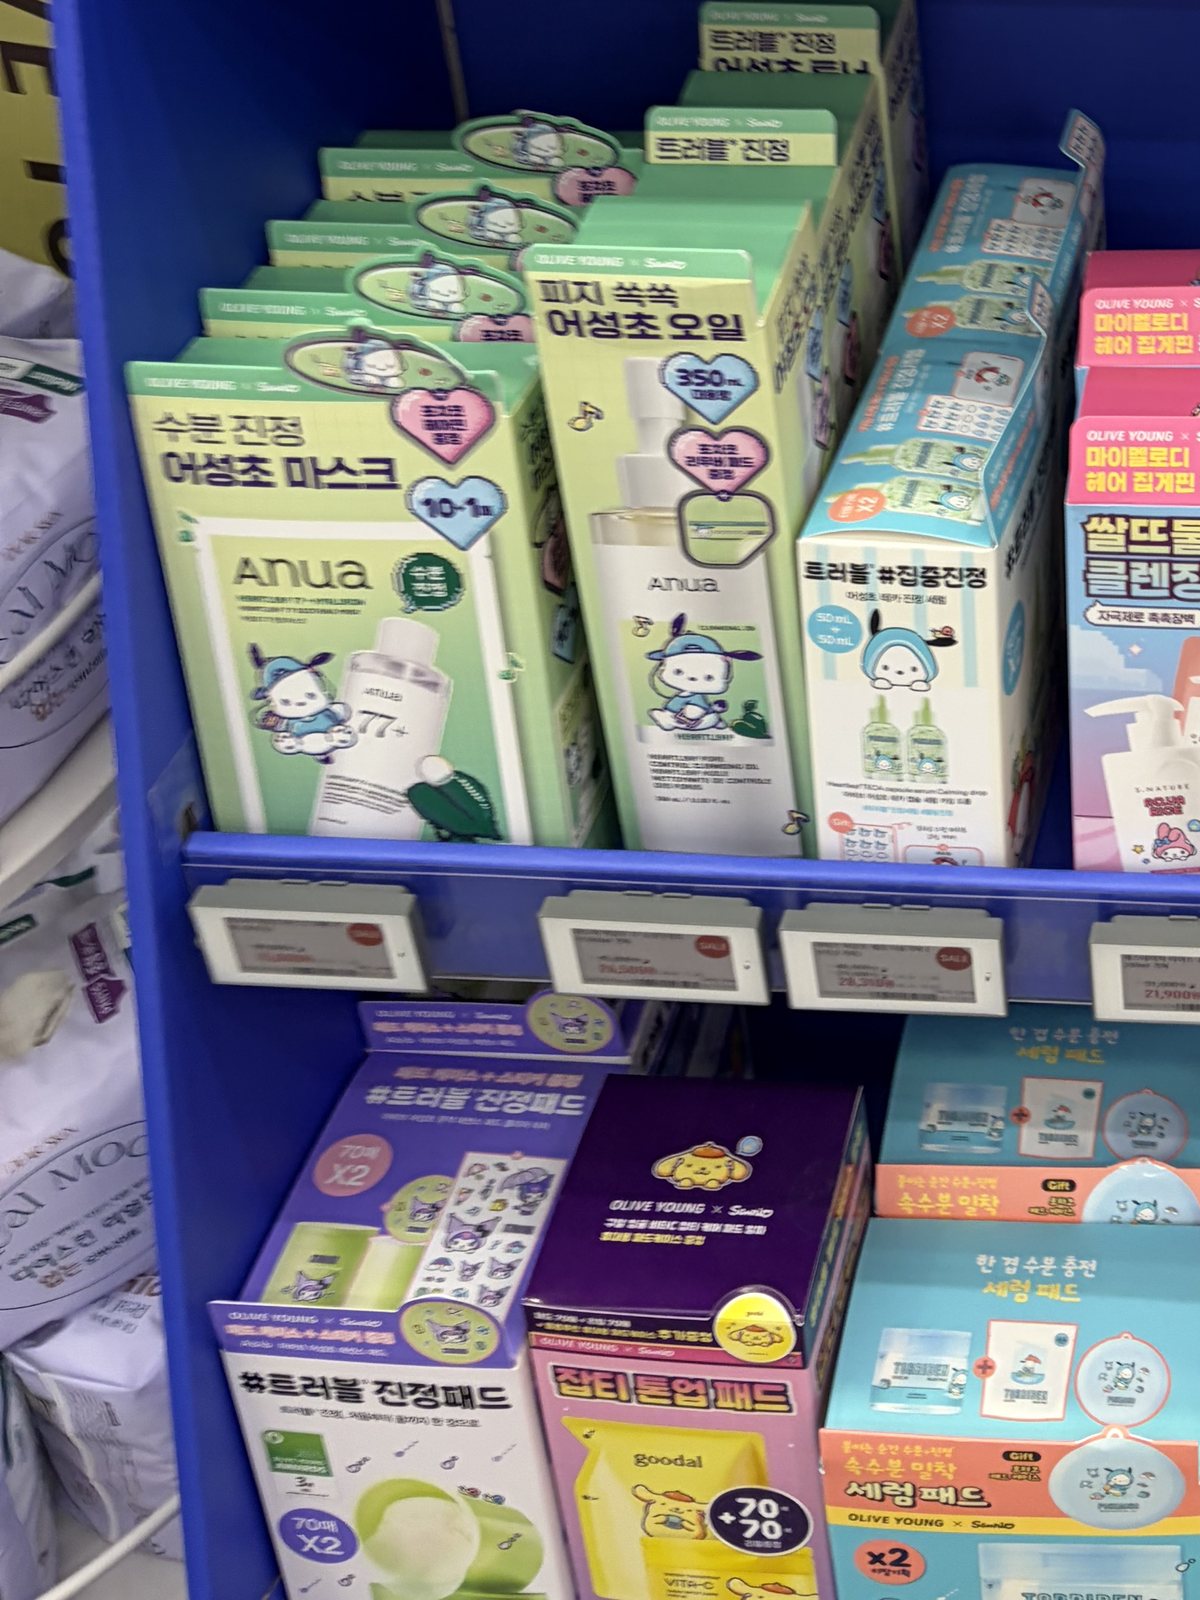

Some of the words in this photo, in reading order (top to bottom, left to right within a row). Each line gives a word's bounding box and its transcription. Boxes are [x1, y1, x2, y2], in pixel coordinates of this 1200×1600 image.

[537, 279, 604, 306] 피지
[1095, 299, 1131, 309] OLIVE
[1133, 298, 1174, 309] YOUNG
[546, 310, 664, 340] 어성초
[668, 313, 747, 342] 오일
[1094, 313, 1189, 332] 마이멜로디
[1094, 335, 1132, 355] 헤어
[1136, 335, 1193, 355] 집게핀
[153, 412, 221, 445] 수분
[231, 415, 305, 447] 진정
[1087, 431, 1125, 442] OLIVE
[1128, 431, 1174, 442] YOUNG
[1086, 447, 1190, 468] 마이멜로디
[161, 451, 278, 488] 어성초
[285, 457, 402, 490] 마스크
[1086, 471, 1127, 493] 헤어
[1133, 472, 1195, 493] 집게핀
[233, 556, 374, 591] Anua
[648, 576, 720, 593] Anua
[804, 561, 871, 584] 트러블
[877, 564, 988, 589] #집중진정
[1008, 1026, 1025, 1041] 한
[1053, 1027, 1083, 1043] 수분
[1017, 1046, 1059, 1064] 세럼
[1064, 1049, 1105, 1064] 패드
[474, 1088, 586, 1116] 진정패드
[1047, 1180, 1070, 1190] Gift
[609, 1200, 654, 1212] OLIVE
[655, 1202, 706, 1214] YOUNG
[727, 1204, 774, 1218] Sanrio
[898, 1192, 954, 1215] 속수분
[975, 1254, 996, 1274] 한
[1002, 1256, 1021, 1275] 겹
[1024, 1256, 1057, 1276] 수분
[1062, 1255, 1098, 1278] 충전
[982, 1279, 1030, 1303] 세럼
[1036, 1282, 1082, 1303] 패드
[238, 1371, 364, 1404] #트러블
[371, 1379, 513, 1411] 진정패드
[553, 1365, 631, 1402] 잡티
[633, 1373, 709, 1409] 톤업
[713, 1379, 792, 1412] 패드
[634, 1453, 702, 1469] goodal
[1009, 1452, 1034, 1461] Gift
[844, 1456, 905, 1479] 속수분
[910, 1462, 958, 1481] 밀착
[845, 1481, 916, 1508] 세럼
[919, 1486, 992, 1508] 패드
[848, 1513, 890, 1524] OLIVE
[893, 1517, 944, 1527] YOUNG
[971, 1520, 1015, 1530] Sanrio
[664, 1576, 714, 1590] VITA-C
